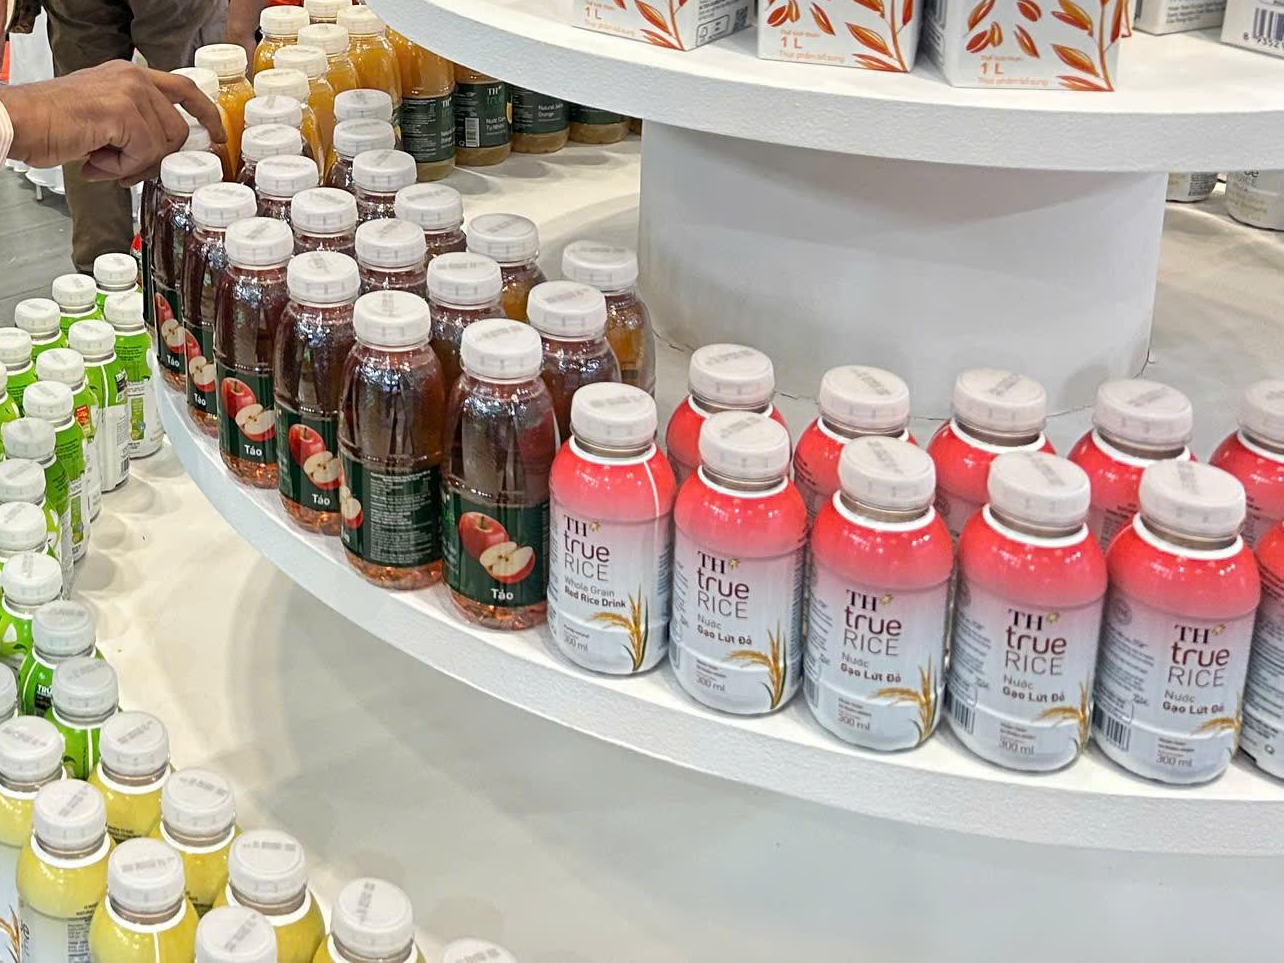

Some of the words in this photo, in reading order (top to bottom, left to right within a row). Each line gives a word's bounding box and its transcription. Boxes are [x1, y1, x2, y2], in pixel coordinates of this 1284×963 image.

[165, 353, 181, 368] Táo
[192, 392, 207, 407] Táo
[243, 443, 263, 458] Táo
[311, 492, 331, 507] Táo
[564, 515, 588, 537] TH
[564, 530, 610, 563] true
[564, 552, 609, 582] RICE
[697, 550, 726, 575] TH
[490, 587, 515, 601] Táo
[590, 582, 615, 598] Grain
[696, 567, 750, 600] true
[580, 592, 600, 607] Rice
[601, 595, 627, 609] Drink
[697, 590, 749, 620] RICE
[846, 589, 878, 612] TH
[844, 605, 903, 637] true
[1008, 608, 1044, 632] TH
[843, 629, 900, 657] RICE
[1006, 626, 1068, 655] true
[1174, 624, 1210, 644] TH
[1005, 649, 1064, 676] RICE
[1171, 641, 1230, 668] true
[1168, 665, 1225, 688] RICE
